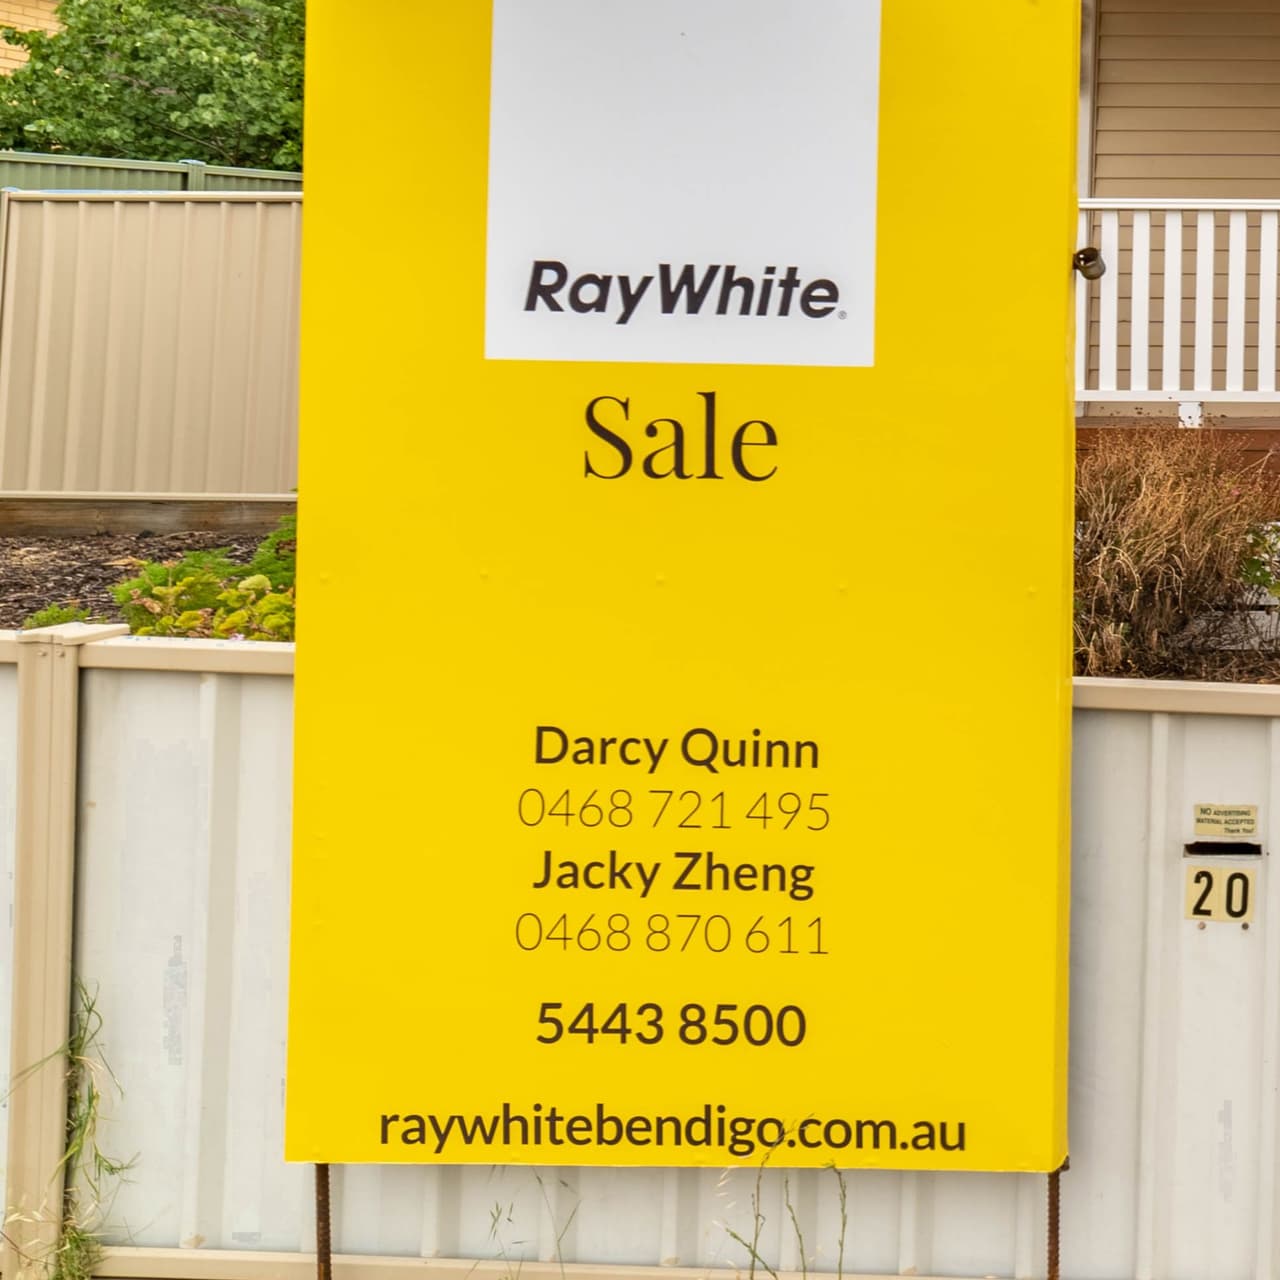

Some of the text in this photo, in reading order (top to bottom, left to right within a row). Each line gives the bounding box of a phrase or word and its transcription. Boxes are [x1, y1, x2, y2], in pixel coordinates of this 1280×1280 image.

[584, 391, 778, 482] Sale
[535, 725, 819, 775] Darcy Quinn
[517, 787, 830, 831] 0468 721 495
[1200, 807, 1212, 816] NO
[532, 849, 815, 902] Jacky Zheng
[1192, 870, 1249, 918] 20
[515, 912, 829, 955] 0468 870 611
[536, 1002, 807, 1048] 5443 8500
[380, 1102, 966, 1157] raywhitebendigo.com.au
